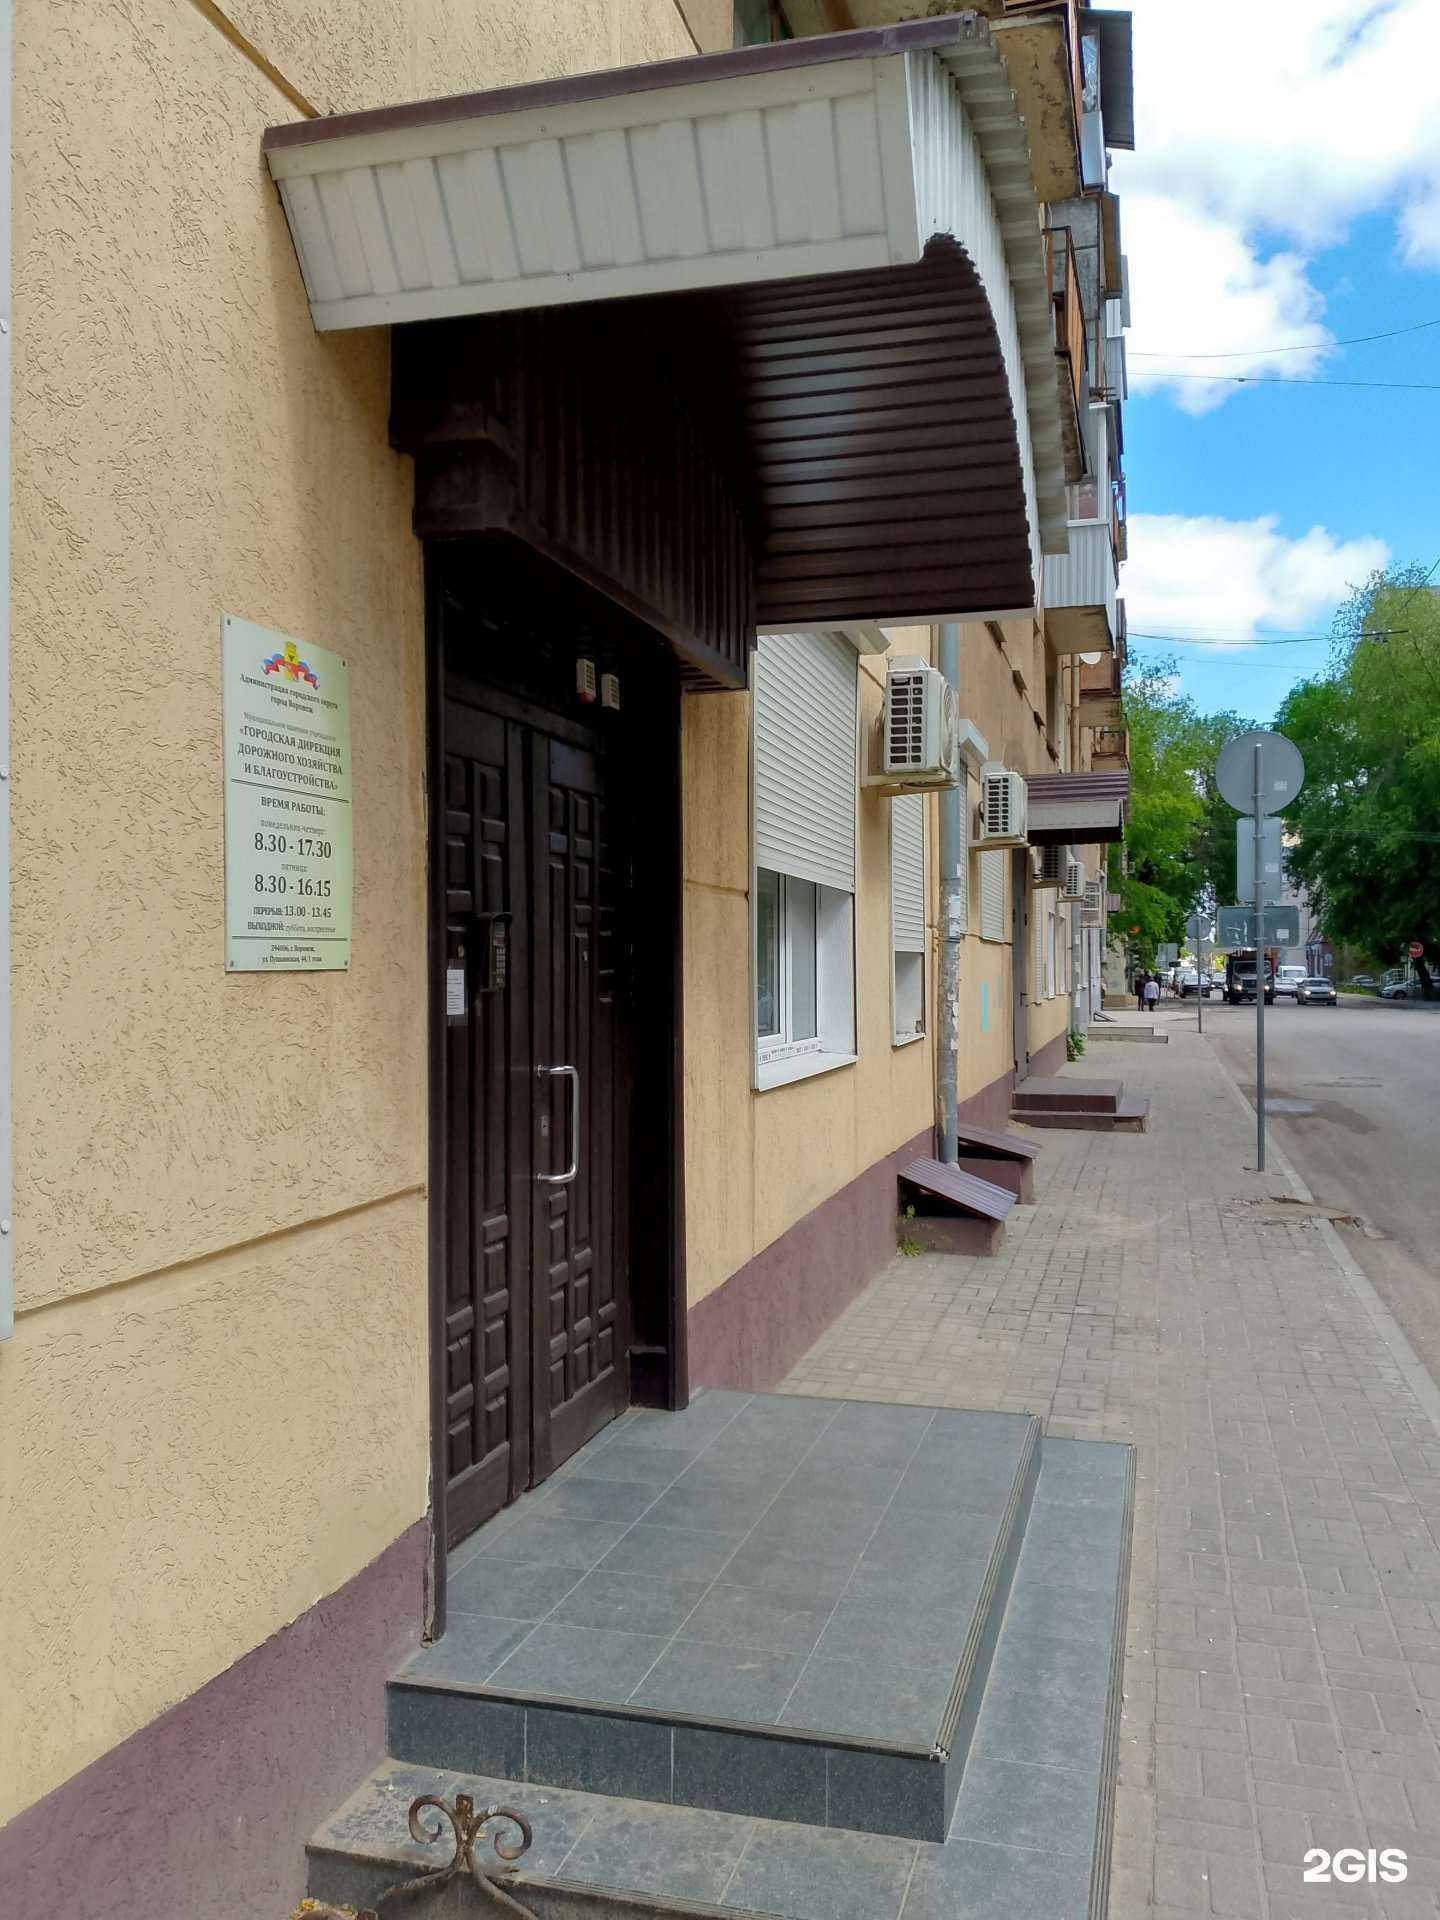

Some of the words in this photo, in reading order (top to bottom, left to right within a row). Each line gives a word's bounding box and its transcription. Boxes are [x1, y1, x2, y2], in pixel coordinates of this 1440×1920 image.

[240, 725, 296, 747] «ГОРОДСКАЯ
[297, 738, 341, 758] ДИРЕКЦИЯ
[237, 742, 295, 765] ДОРОЖНОГО
[296, 754, 343, 775] ХОЗЯЙСТВА
[253, 764, 338, 791] БЛАГОУСТРОЙСТВА»
[261, 796, 290, 811] ВРЕМЯ
[291, 801, 326, 817] РАБОТЫ:
[254, 832, 287, 854] 8.30
[297, 838, 332, 859] 17.30
[254, 873, 287, 895] 8.30
[297, 878, 331, 897] 16.15
[285, 905, 306, 917] 13.00
[311, 906, 332, 918] 13.45
